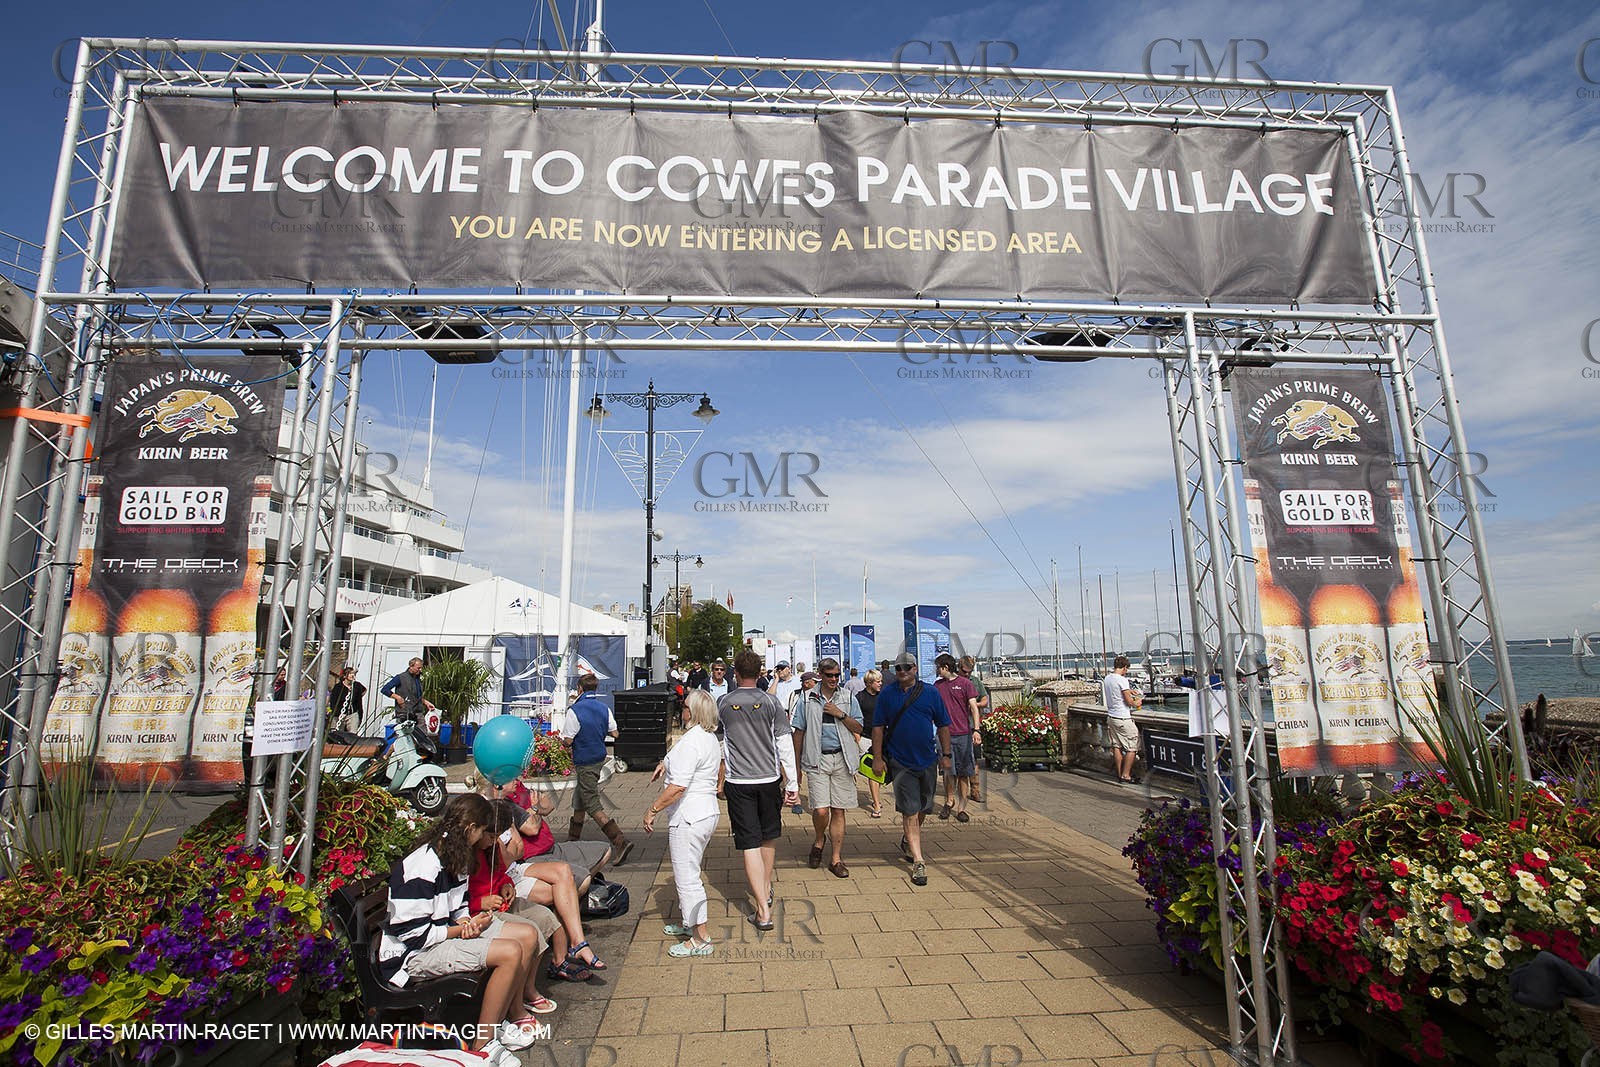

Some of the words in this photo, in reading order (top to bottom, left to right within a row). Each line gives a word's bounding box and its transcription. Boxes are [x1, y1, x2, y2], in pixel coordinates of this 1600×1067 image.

[160, 143, 482, 194] WELCOME
[504, 149, 584, 195] TO
[606, 155, 835, 208] COWES
[857, 156, 1091, 210] PARADE
[1105, 167, 1335, 216] VILLAGE
[450, 215, 516, 239] YOU
[525, 218, 582, 241] ARE
[594, 221, 671, 248] NOW
[680, 227, 822, 253] ENTERING
[831, 228, 853, 251] A
[863, 227, 997, 253] LICENSED
[1007, 231, 1082, 254] AREA
[114, 371, 174, 417] JAPAN'S
[180, 369, 231, 388] PRIME
[230, 380, 266, 415] BREW
[1248, 382, 1293, 425] JAPAN'S
[1294, 380, 1340, 398] PRIME
[1341, 391, 1379, 424] BREW
[138, 447, 182, 460] KIRIN
[189, 447, 229, 460] BEER
[1280, 453, 1320, 465] KIRIN
[1324, 453, 1358, 465] BEER
[126, 491, 172, 504] SAIL
[183, 490, 223, 504] FOR
[1284, 494, 1326, 506] SAIL
[1335, 494, 1367, 506] FOR
[124, 506, 177, 520] GOLD
[1288, 508, 1334, 521] GOLD
[103, 558, 157, 568] THE
[164, 558, 239, 568] DECK
[1277, 556, 1325, 566] THE
[1331, 556, 1393, 565] DECK
[1279, 688, 1305, 700] BEER
[1324, 687, 1357, 699] KIRIN
[1359, 685, 1387, 697] BEER
[61, 700, 92, 711] BEER
[112, 700, 150, 711] KIRIN
[154, 700, 186, 711] BEER
[205, 699, 242, 711] KIRIN
[1329, 718, 1350, 728] KIRIN
[1354, 717, 1389, 727] ICHIBAN
[106, 733, 133, 744] KIRIN
[137, 733, 177, 744] ICHIBAN
[202, 733, 228, 743] KIRIN
[1150, 745, 1176, 763] THE
